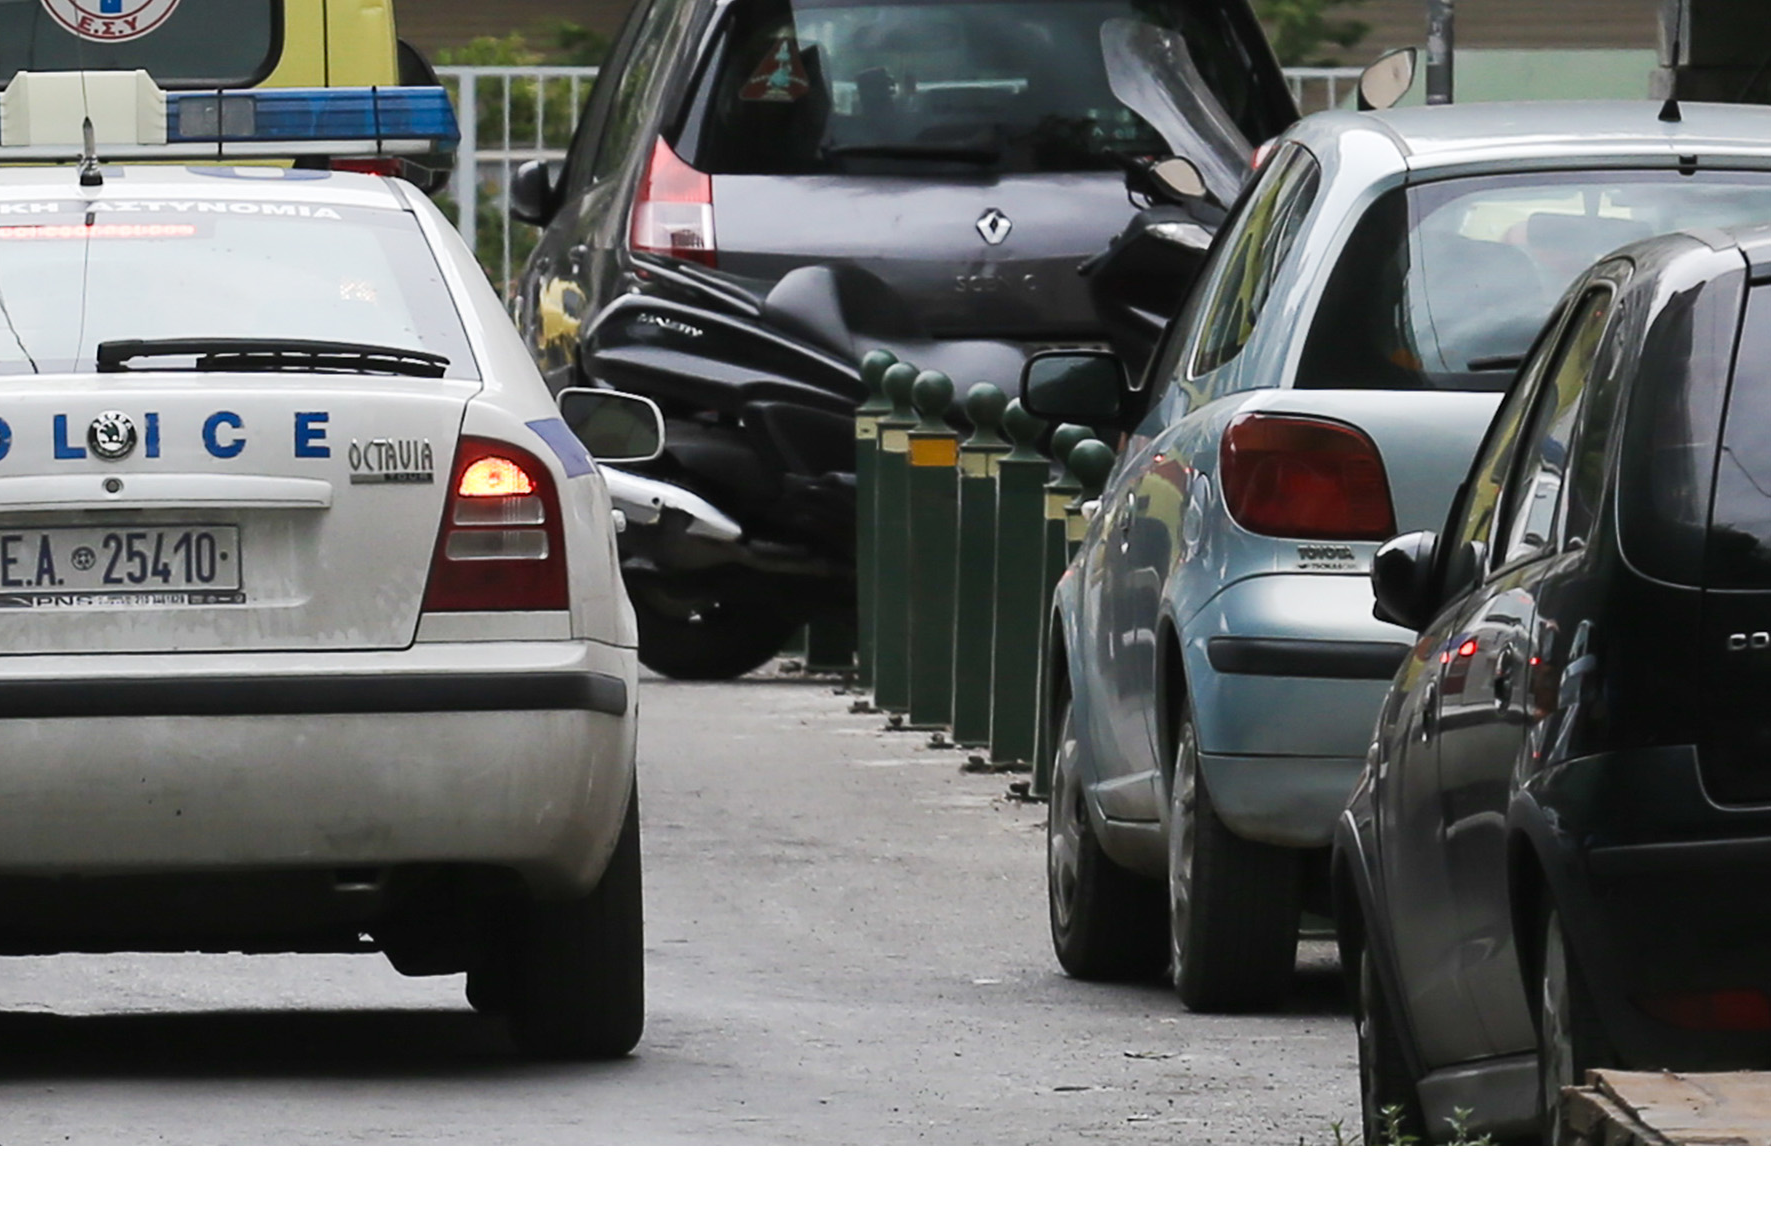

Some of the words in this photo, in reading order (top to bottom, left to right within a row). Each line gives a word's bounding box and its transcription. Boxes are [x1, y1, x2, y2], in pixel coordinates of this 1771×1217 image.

[86, 199, 343, 221] ΑΣΤΥΝΟΜΙΑ
[348, 438, 434, 472] OCTAVIA
[101, 531, 217, 585] 25410
[1297, 544, 1355, 561] TOYOTA
